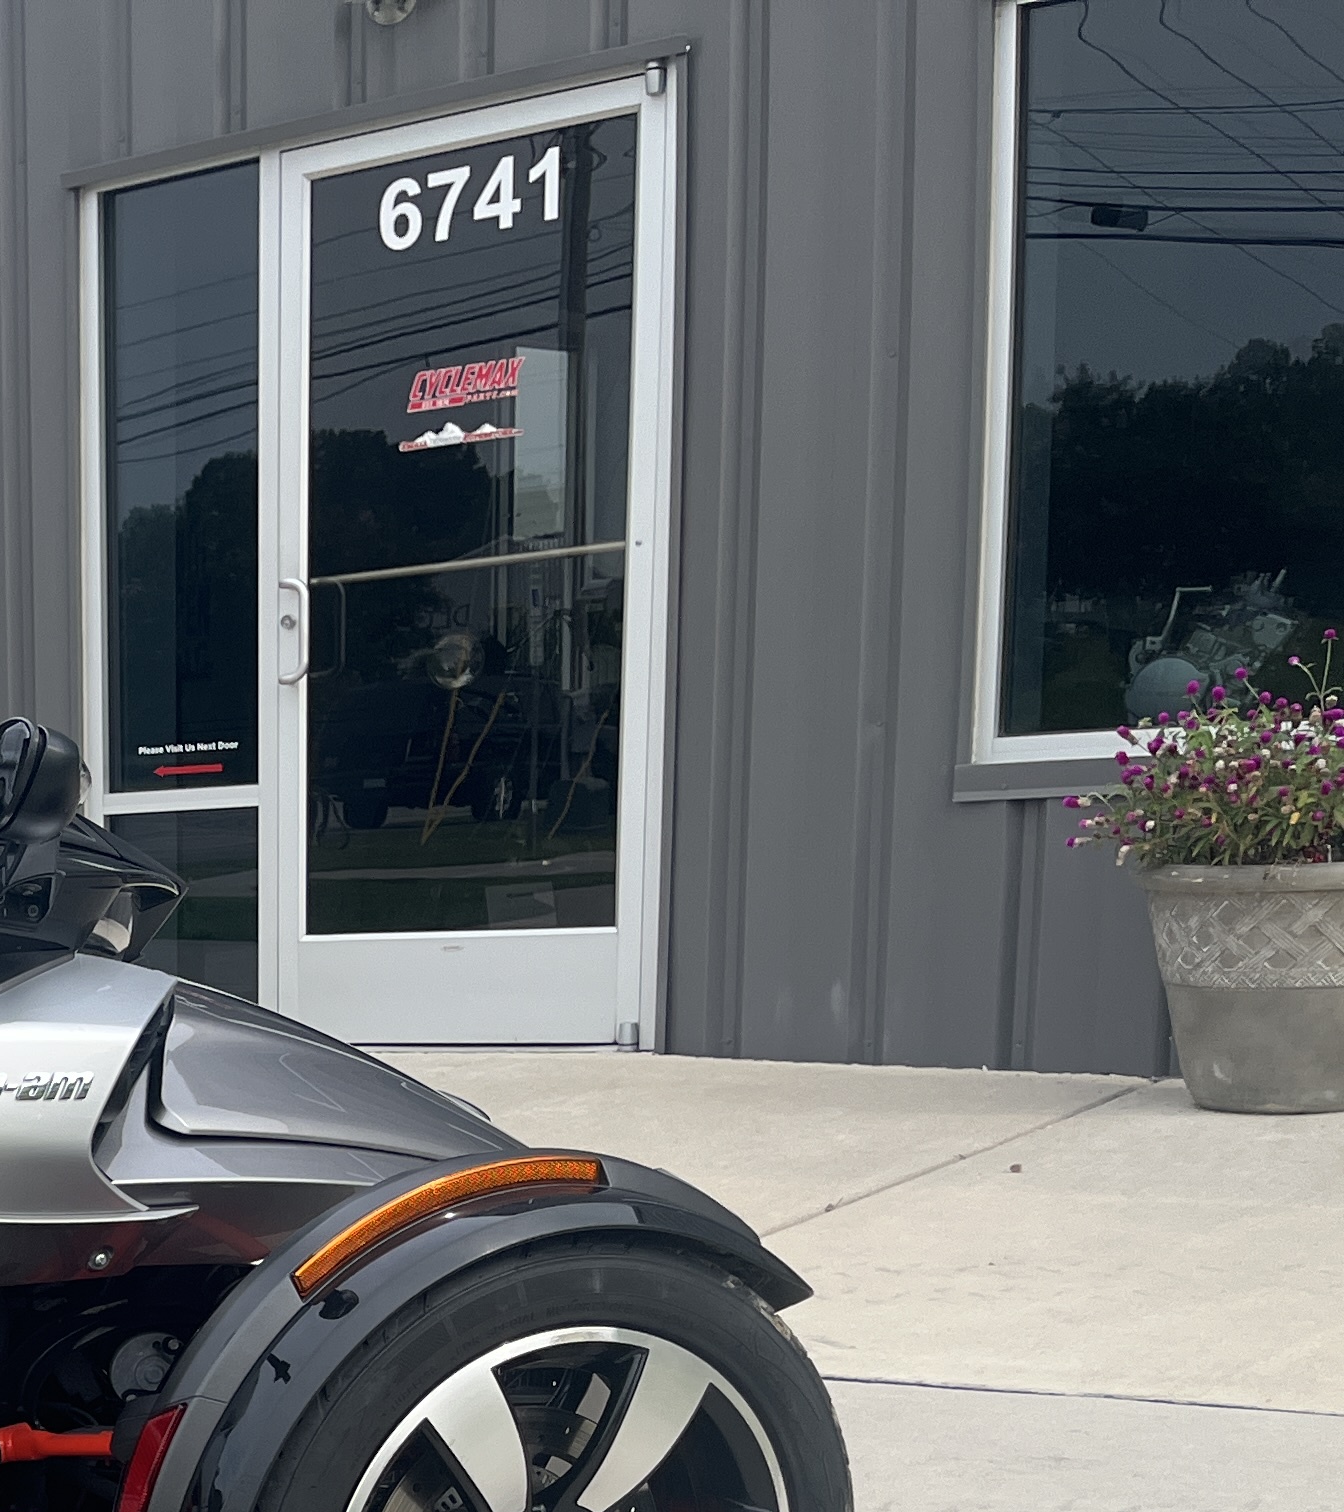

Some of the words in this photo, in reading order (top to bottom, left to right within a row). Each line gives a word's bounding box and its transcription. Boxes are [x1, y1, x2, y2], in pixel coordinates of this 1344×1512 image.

[378, 145, 561, 252] 6741
[408, 356, 526, 401] CYCLEMAX
[138, 746, 164, 755] Please
[165, 744, 184, 753] Visit
[184, 743, 196, 752] Us
[196, 742, 216, 751] Next
[217, 741, 239, 750] Door
